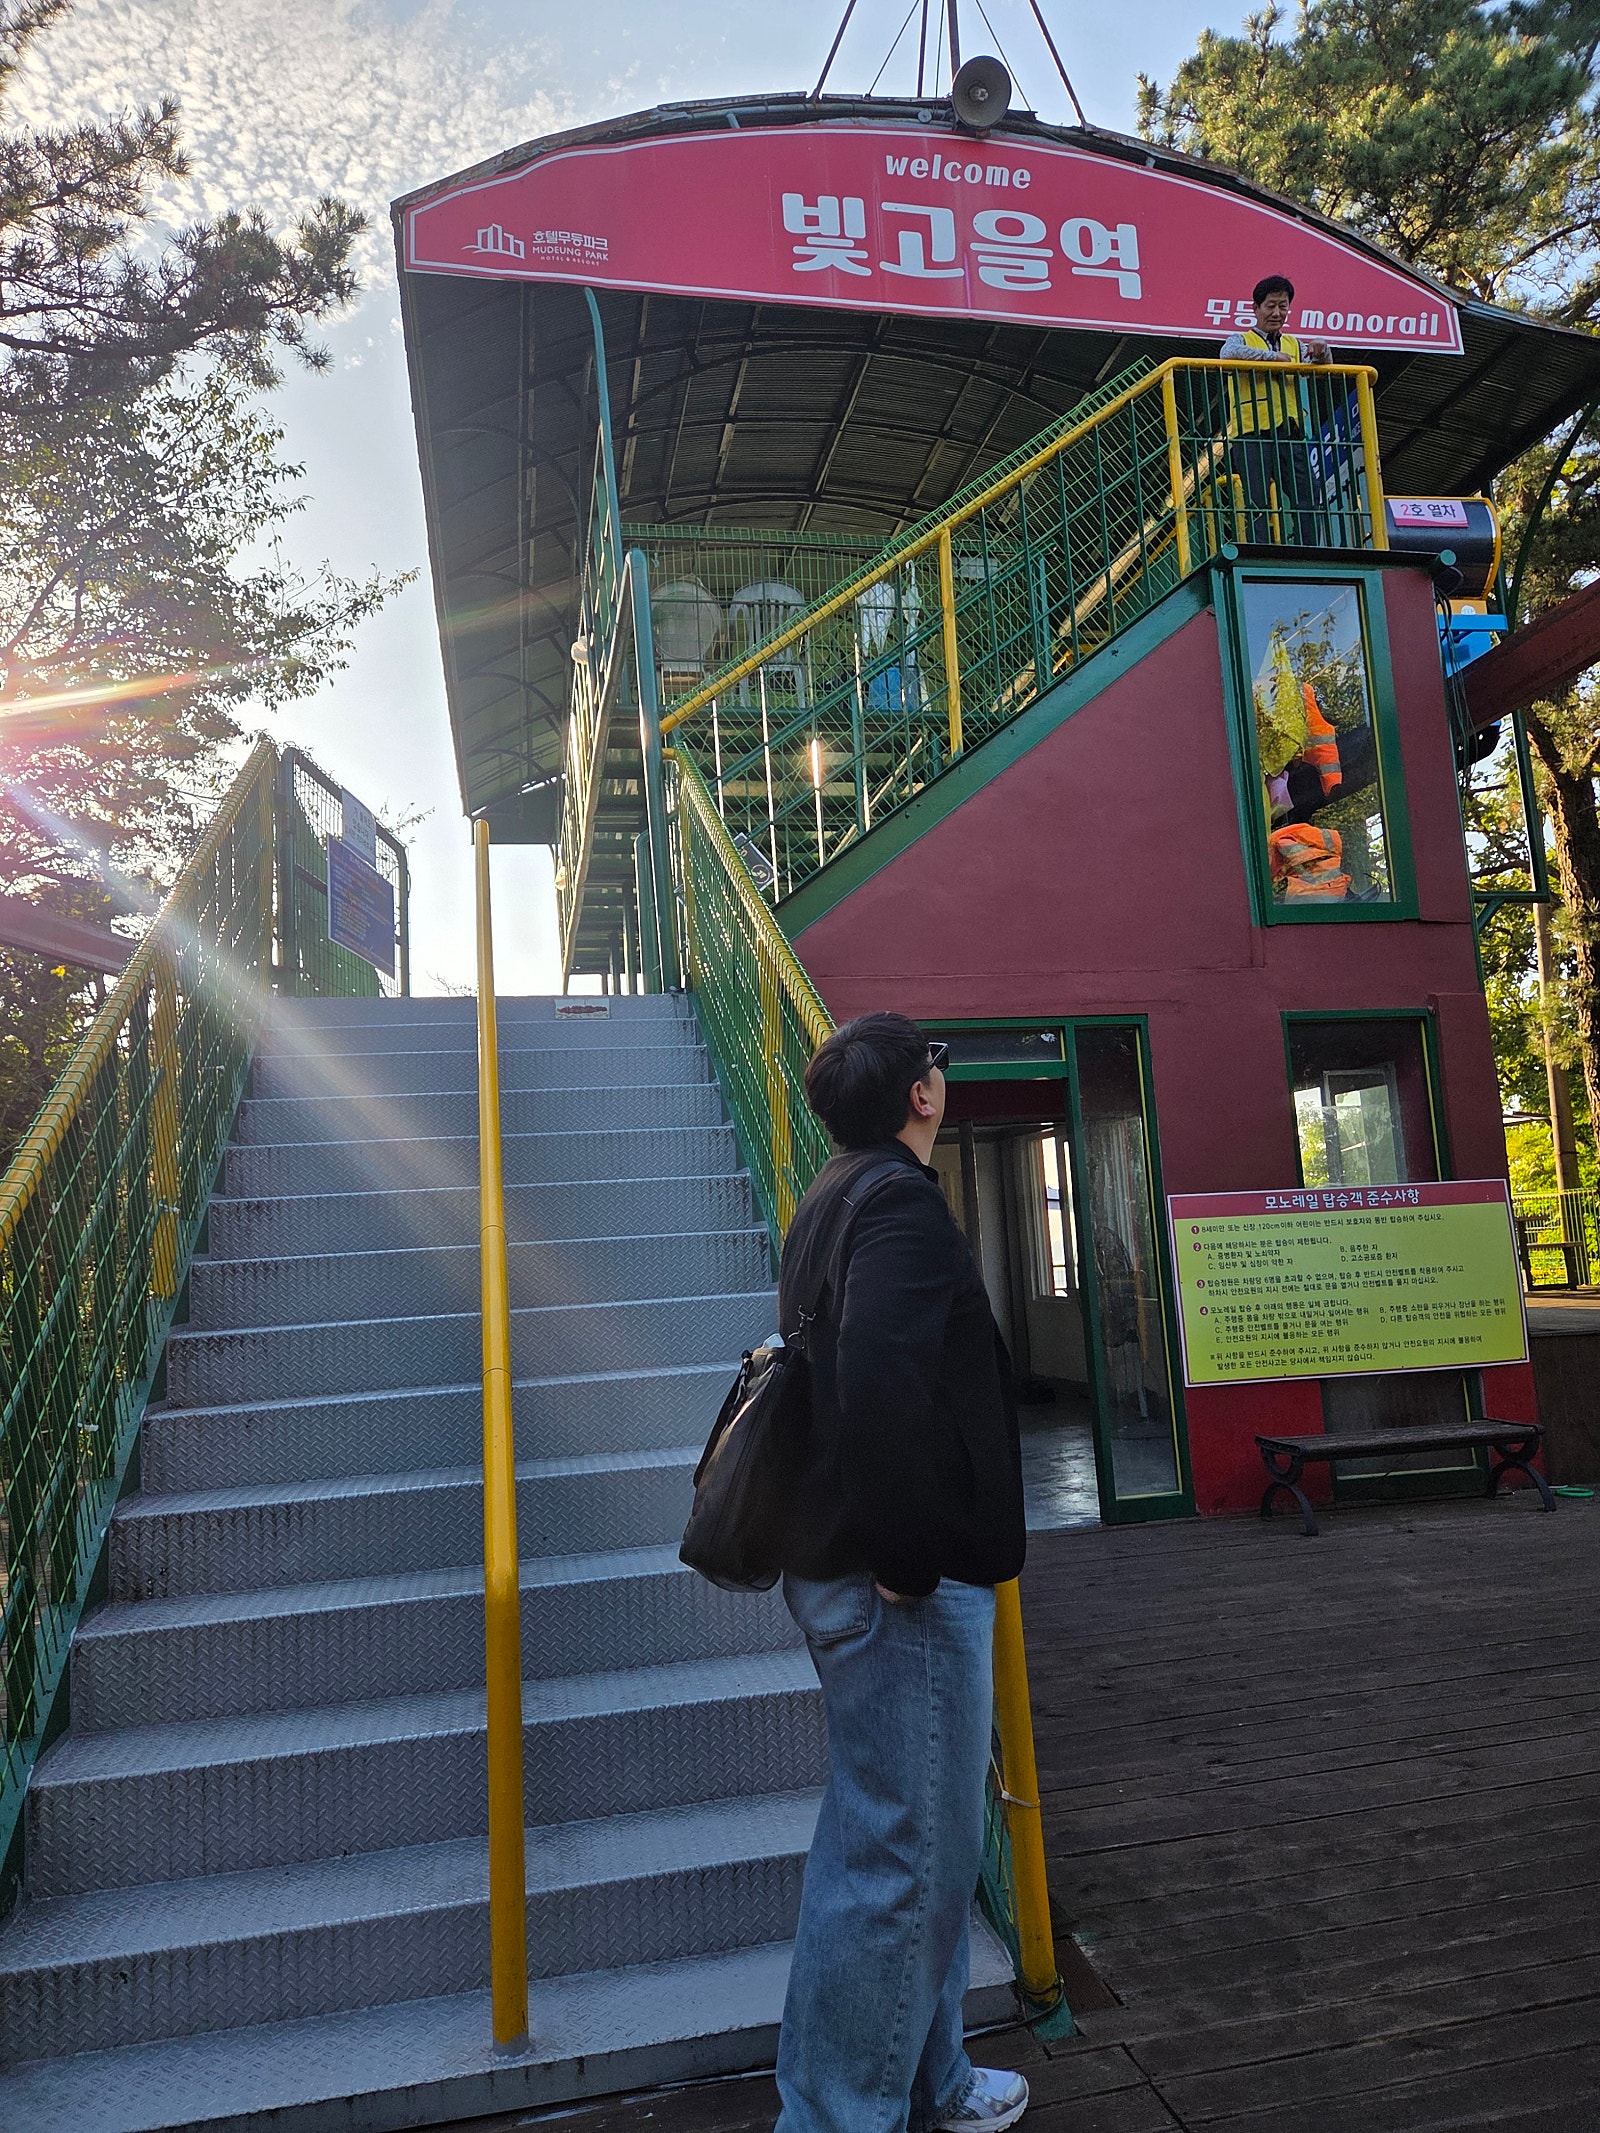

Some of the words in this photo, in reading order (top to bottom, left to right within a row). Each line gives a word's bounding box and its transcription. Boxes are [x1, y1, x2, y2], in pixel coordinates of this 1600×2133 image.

[885, 154, 1031, 190] welcome
[533, 230, 608, 250] 호텔무등파크
[782, 192, 1142, 300] 빛고을역
[532, 246, 581, 257] MUDEUNG
[585, 250, 609, 261] PARK
[572, 257, 600, 267] RESORT
[1300, 309, 1439, 336] monorail
[1400, 503, 1425, 516] 2호
[1427, 503, 1456, 518] 열차
[1265, 1193, 1318, 1210] 모노레일
[1322, 1191, 1362, 1207] 탑승객
[1366, 1189, 1419, 1205] 준수사항
[1227, 1224, 1239, 1232] 또는
[1242, 1223, 1255, 1232] 신장
[1295, 1220, 1321, 1229] 어린이는
[1323, 1219, 1343, 1228] 반드시
[1346, 1217, 1371, 1227] 보호자와
[1374, 1217, 1386, 1225] 동반
[1389, 1215, 1415, 1224] 탑승하여
[1417, 1214, 1444, 1223] 주십시오.
[1203, 1241, 1222, 1250] 다음에
[1225, 1240, 1257, 1249] 해당하시는
[1259, 1239, 1272, 1248] 분은
[1275, 1238, 1294, 1247] 탑승이
[1297, 1237, 1331, 1246] 제한됩니다.
[1339, 1245, 1347, 1253] B.
[1349, 1244, 1368, 1253] 음주한
[1371, 1243, 1377, 1252] 자
[1207, 1252, 1214, 1260] A.
[1217, 1250, 1242, 1260] 중병환자
[1245, 1250, 1252, 1258] 및
[1340, 1254, 1348, 1263] D.
[1351, 1253, 1382, 1262] 고소공포증
[1385, 1252, 1397, 1261] 환자
[1208, 1262, 1215, 1270] C.
[1240, 1260, 1246, 1269] 및
[1249, 1259, 1268, 1268] 심장이
[1270, 1258, 1283, 1267] 약한
[1286, 1258, 1292, 1266] 자
[1207, 1277, 1239, 1286] 탑승정원은
[1242, 1276, 1261, 1285] 차량당
[1284, 1273, 1302, 1282] 초과할
[1306, 1273, 1312, 1281] 수
[1314, 1271, 1336, 1281] 없으며,
[1339, 1270, 1351, 1279] 탑승
[1354, 1270, 1360, 1278] 후
[1363, 1269, 1382, 1278] 반드시
[1384, 1267, 1416, 1277] 안전벨트를
[1445, 1264, 1464, 1273] 주시고
[1208, 1288, 1228, 1297] 하차시
[1230, 1286, 1262, 1296] 안전요원의
[1265, 1285, 1278, 1294] 지시
[1281, 1284, 1300, 1293] 전에는
[1325, 1282, 1337, 1291] 문을
[1340, 1281, 1359, 1290] 열거나
[1361, 1279, 1393, 1289] 안전벨트를
[1411, 1277, 1438, 1286] 마십시오.
[1210, 1304, 1236, 1314] 모노레일
[1238, 1304, 1251, 1312] 탑승
[1254, 1303, 1260, 1312] 후
[1263, 1302, 1283, 1311] 아래의
[1285, 1301, 1305, 1310] 행동은
[1307, 1300, 1320, 1309] 일체
[1323, 1298, 1351, 1308] 금합니다.
[1379, 1305, 1386, 1314] B.
[1389, 1304, 1407, 1313] 주행중
[1431, 1301, 1456, 1310] 피우거나
[1458, 1300, 1476, 1309] 장난을
[1478, 1299, 1490, 1307] 하는
[1493, 1298, 1505, 1306] 행위
[1214, 1316, 1221, 1325] A.
[1224, 1315, 1243, 1324] 주행중
[1246, 1314, 1258, 1323] 몸을
[1262, 1313, 1274, 1322] 차량
[1299, 1310, 1325, 1319] 내밀거나
[1327, 1308, 1353, 1318] 일어서는
[1356, 1307, 1369, 1316] 행위
[1380, 1315, 1387, 1324] D.
[1390, 1314, 1402, 1323] 다른
[1405, 1312, 1430, 1322] 탑승객의
[1432, 1311, 1450, 1320] 안전을
[1454, 1309, 1477, 1319] 위협하는
[1480, 1308, 1491, 1317] 모든
[1494, 1307, 1506, 1316] 행위
[1214, 1326, 1222, 1334] C.
[1225, 1324, 1244, 1334] 주행중
[1247, 1322, 1279, 1332] 안전벨트를
[1304, 1320, 1316, 1329] 문을
[1319, 1319, 1332, 1328] 여는
[1335, 1318, 1348, 1327] 행위
[1216, 1336, 1222, 1344] E.
[1225, 1333, 1257, 1343] 안전요원의
[1260, 1332, 1279, 1341] 지시에
[1282, 1330, 1308, 1340] 불응하는
[1311, 1330, 1323, 1338] 모든
[1326, 1328, 1340, 1337] 행위
[1225, 1351, 1244, 1360] 사항을
[1247, 1349, 1266, 1359] 반드시
[1269, 1348, 1295, 1357] 준수하여
[1298, 1346, 1320, 1355] 주시고,
[1322, 1345, 1328, 1354] 위
[1331, 1344, 1350, 1353] 사항을
[1353, 1342, 1379, 1352] 준수하지
[1381, 1341, 1400, 1350] 않거나
[1403, 1339, 1434, 1349] 안전요원의
[1437, 1337, 1455, 1346] 지시에
[1458, 1336, 1482, 1345] 불응하여
[1216, 1361, 1236, 1370] 발생한
[1239, 1360, 1251, 1368] 모든
[1254, 1358, 1287, 1368] 안전사고는
[1289, 1356, 1315, 1366] 당사에서
[1318, 1355, 1344, 1364] 책임지지
[1346, 1353, 1375, 1363] 않습니다.
